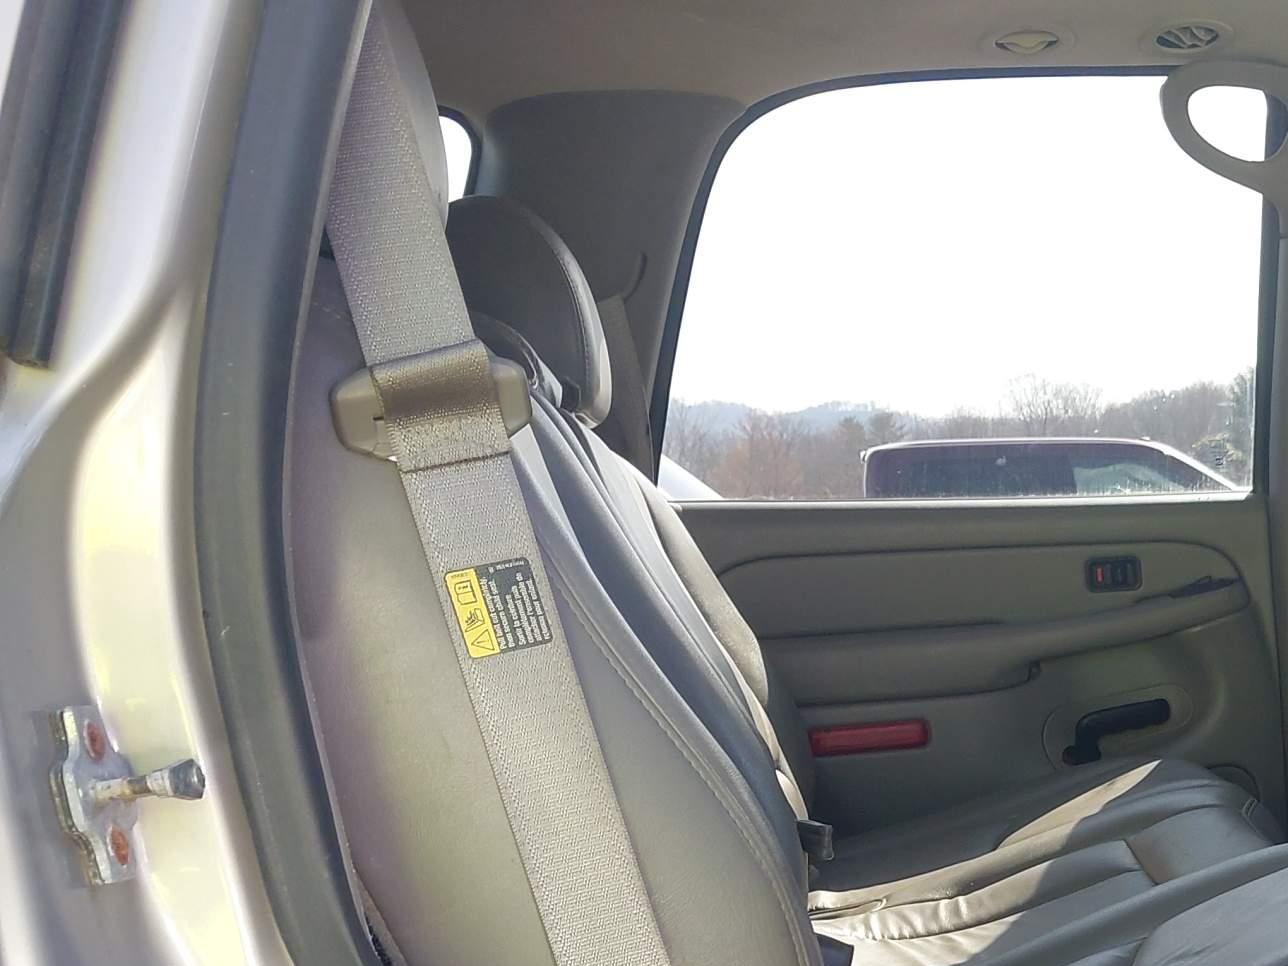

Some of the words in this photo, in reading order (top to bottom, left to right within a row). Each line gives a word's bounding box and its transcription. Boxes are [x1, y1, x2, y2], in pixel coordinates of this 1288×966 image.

[514, 572, 523, 581] de
[492, 594, 503, 610] child
[489, 612, 498, 623] out
[498, 611, 510, 632] secure
[497, 637, 507, 649] Pull
[505, 632, 515, 647] then
